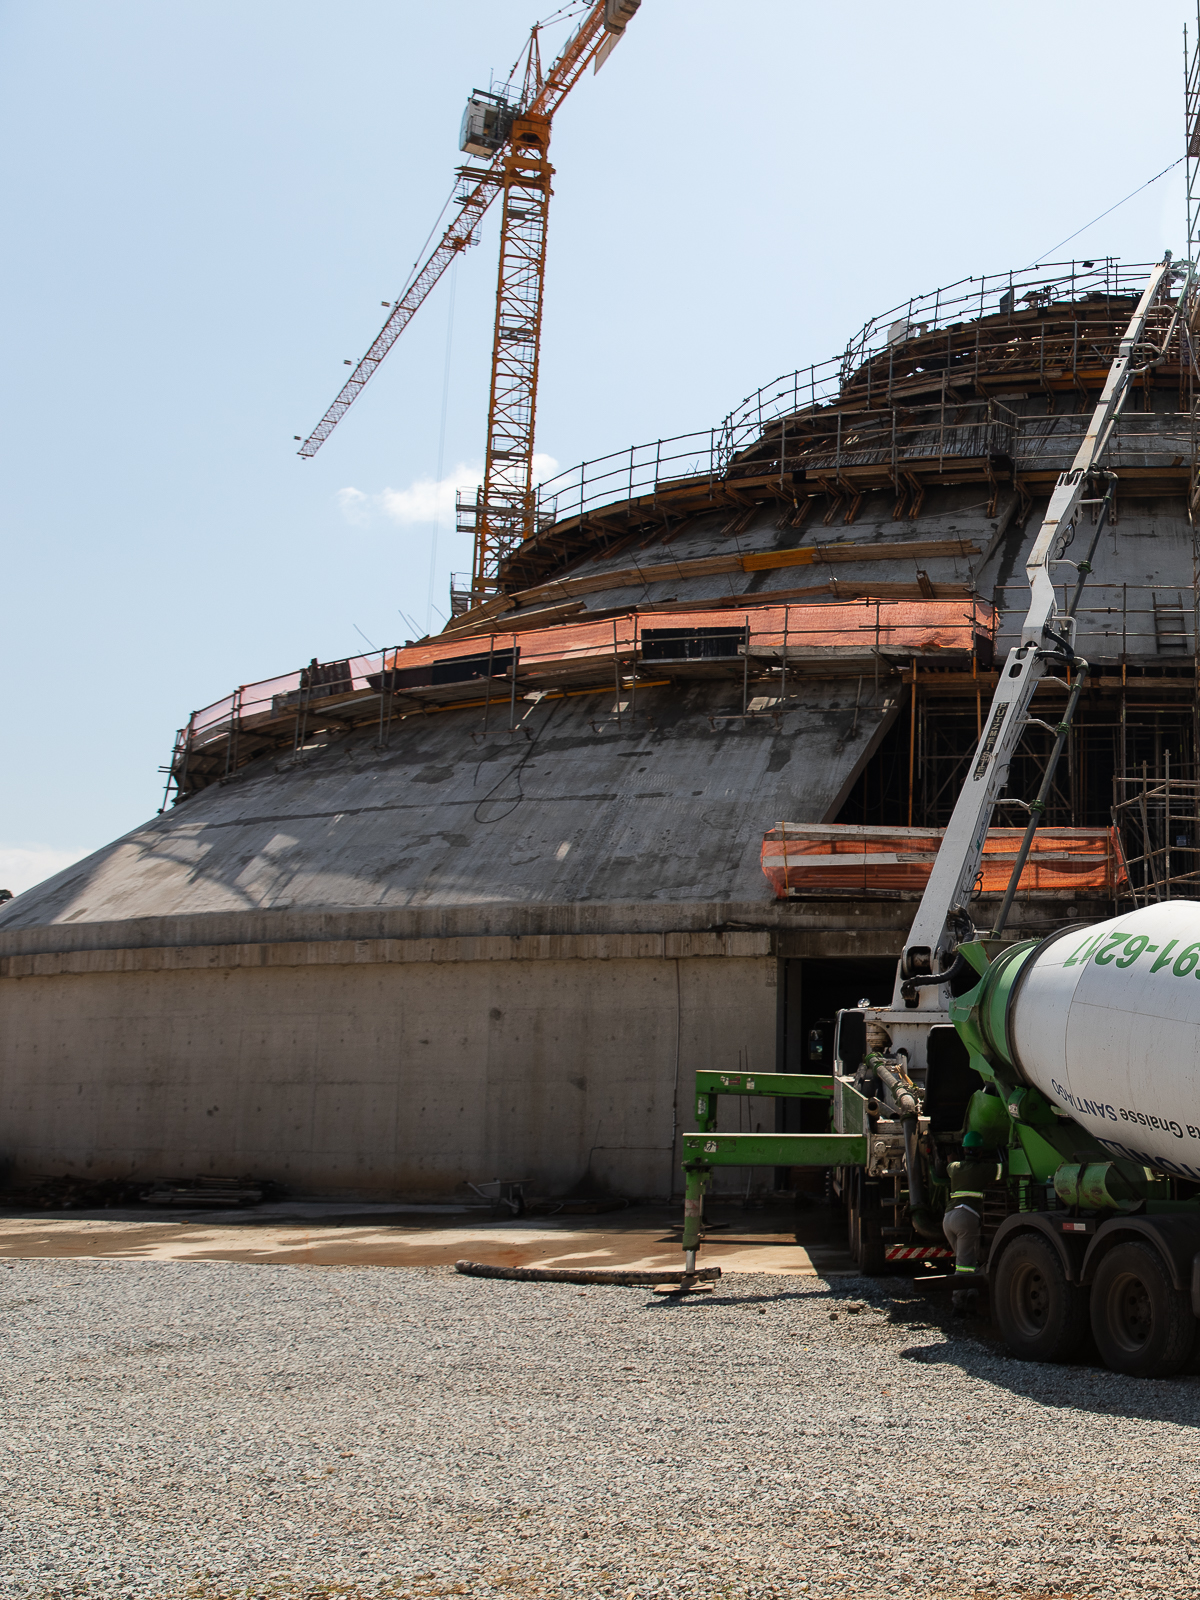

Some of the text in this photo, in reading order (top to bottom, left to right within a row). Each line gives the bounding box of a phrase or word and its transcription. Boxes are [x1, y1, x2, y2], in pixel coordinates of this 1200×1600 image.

[974, 703, 1007, 780] PUTZMEISTER
[1051, 1078, 1118, 1121] SANTIAGO
[1120, 1107, 1184, 1139] Gnaisse
